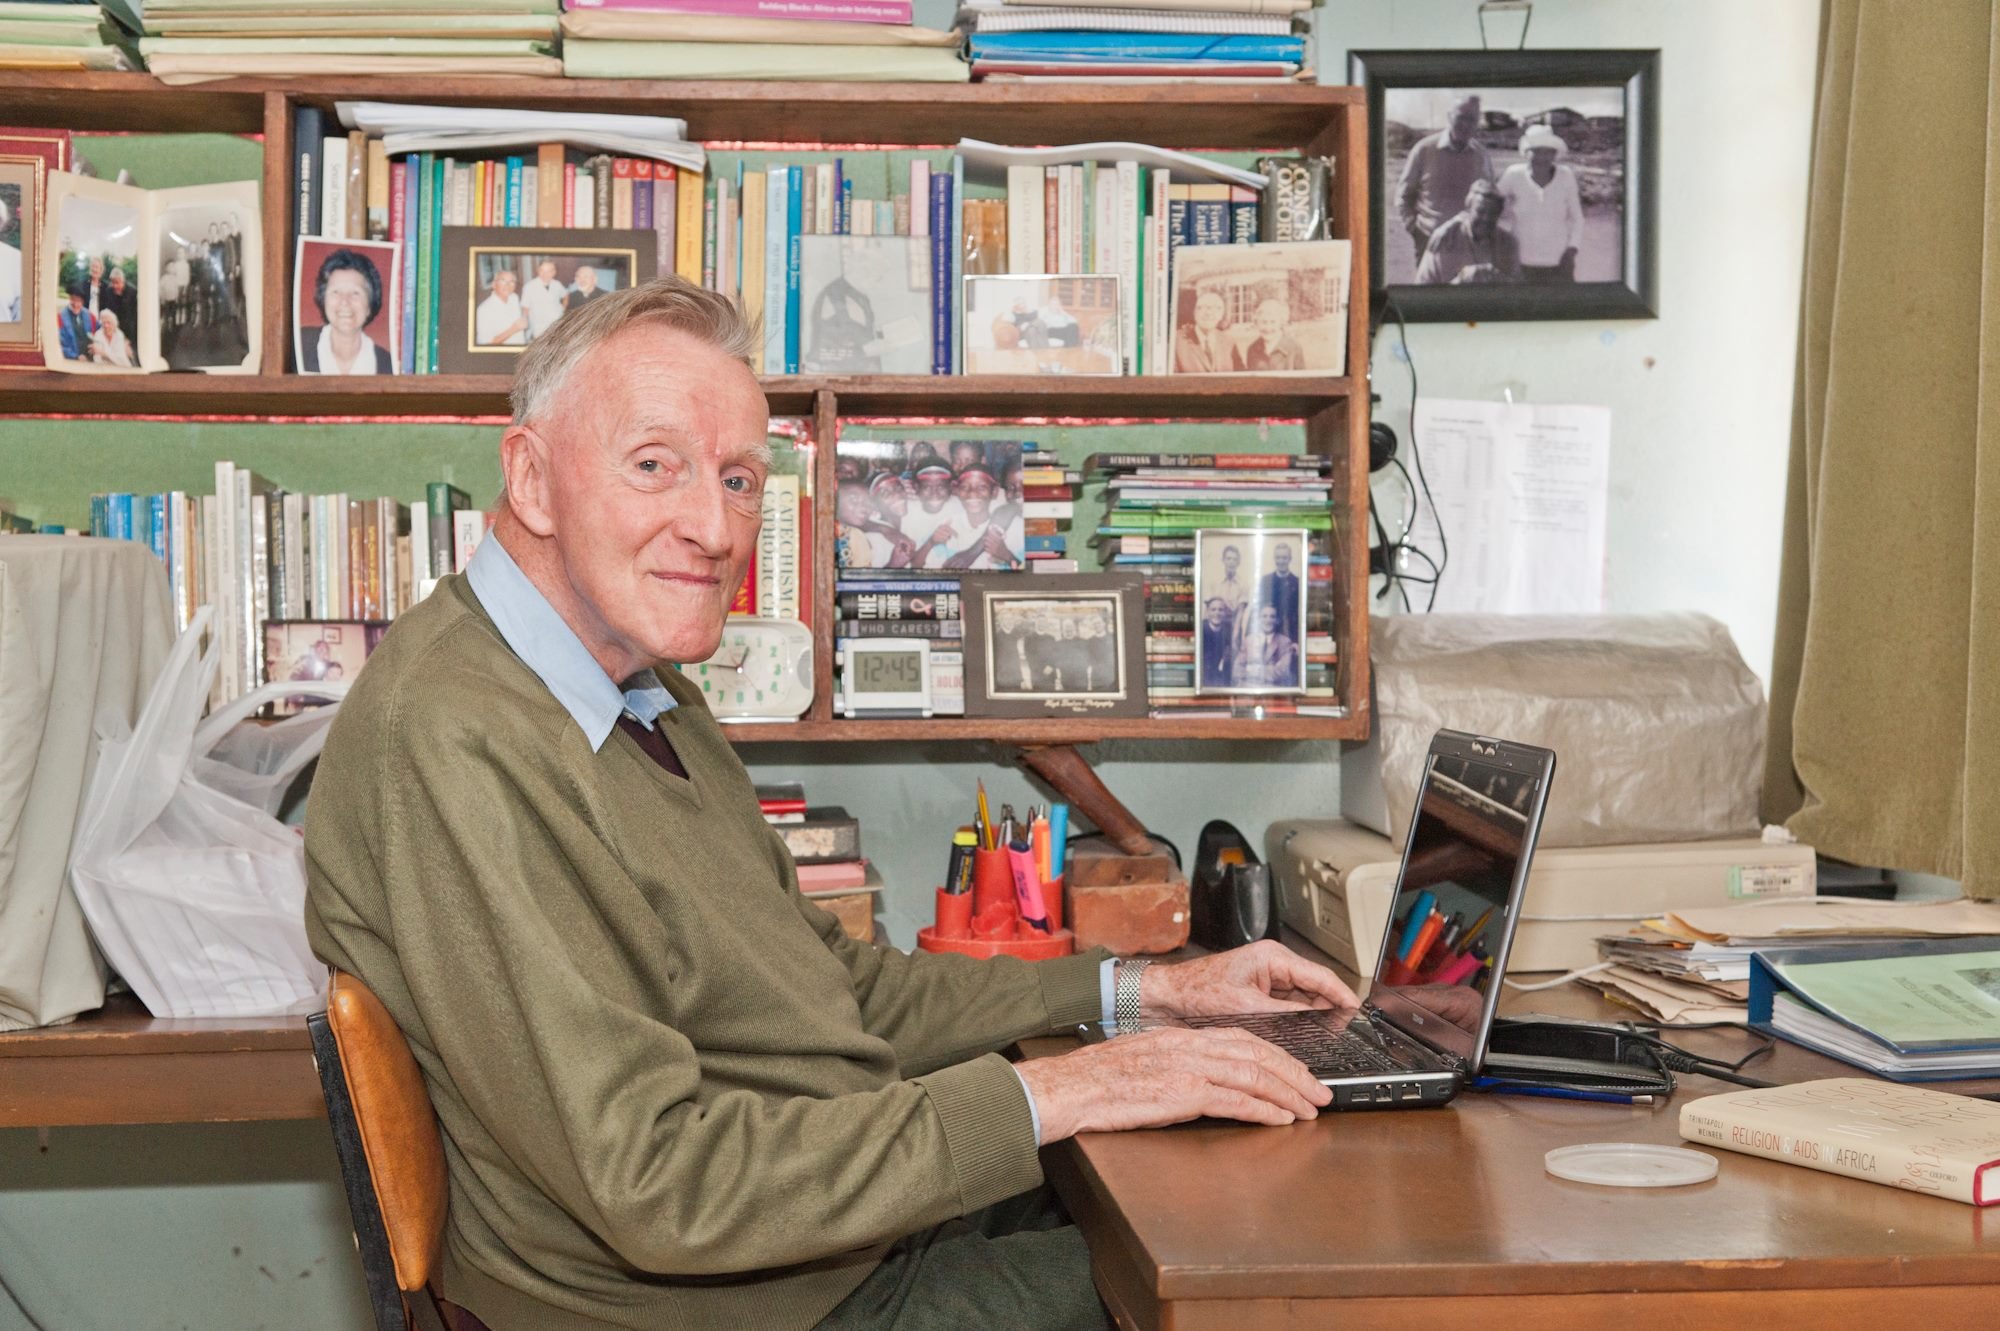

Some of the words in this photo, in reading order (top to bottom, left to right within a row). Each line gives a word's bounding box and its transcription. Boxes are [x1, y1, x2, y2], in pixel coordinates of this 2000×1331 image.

[758, 1, 788, 12] Building
[813, 3, 853, 13] Africa-wide
[854, 5, 882, 16] briefing
[882, 7, 902, 15] notes
[1170, 201, 1186, 233] The
[1293, 167, 1311, 241] CONCIS
[1194, 204, 1209, 244] Englis
[1209, 205, 1222, 244] Fowle
[1109, 455, 1151, 465] ACKERMANN
[762, 490, 776, 589] CATHOLIC
[779, 490, 793, 602] CATECHISM
[858, 594, 877, 619] THE
[887, 594, 901, 619] CURE
[860, 623, 885, 634] WHO
[891, 623, 939, 634] CARES?
[863, 656, 919, 683] 12:45
[1688, 1114, 1724, 1129] TRINITAPOLI
[1697, 1128, 1724, 1141] WEINREB
[1731, 1125, 1781, 1153] RELIGION
[1793, 1138, 1819, 1162] AIDS
[1821, 1143, 1834, 1165] IN
[1835, 1146, 1877, 1173] AFRICA
[1928, 1169, 1959, 1183] OXFORD
